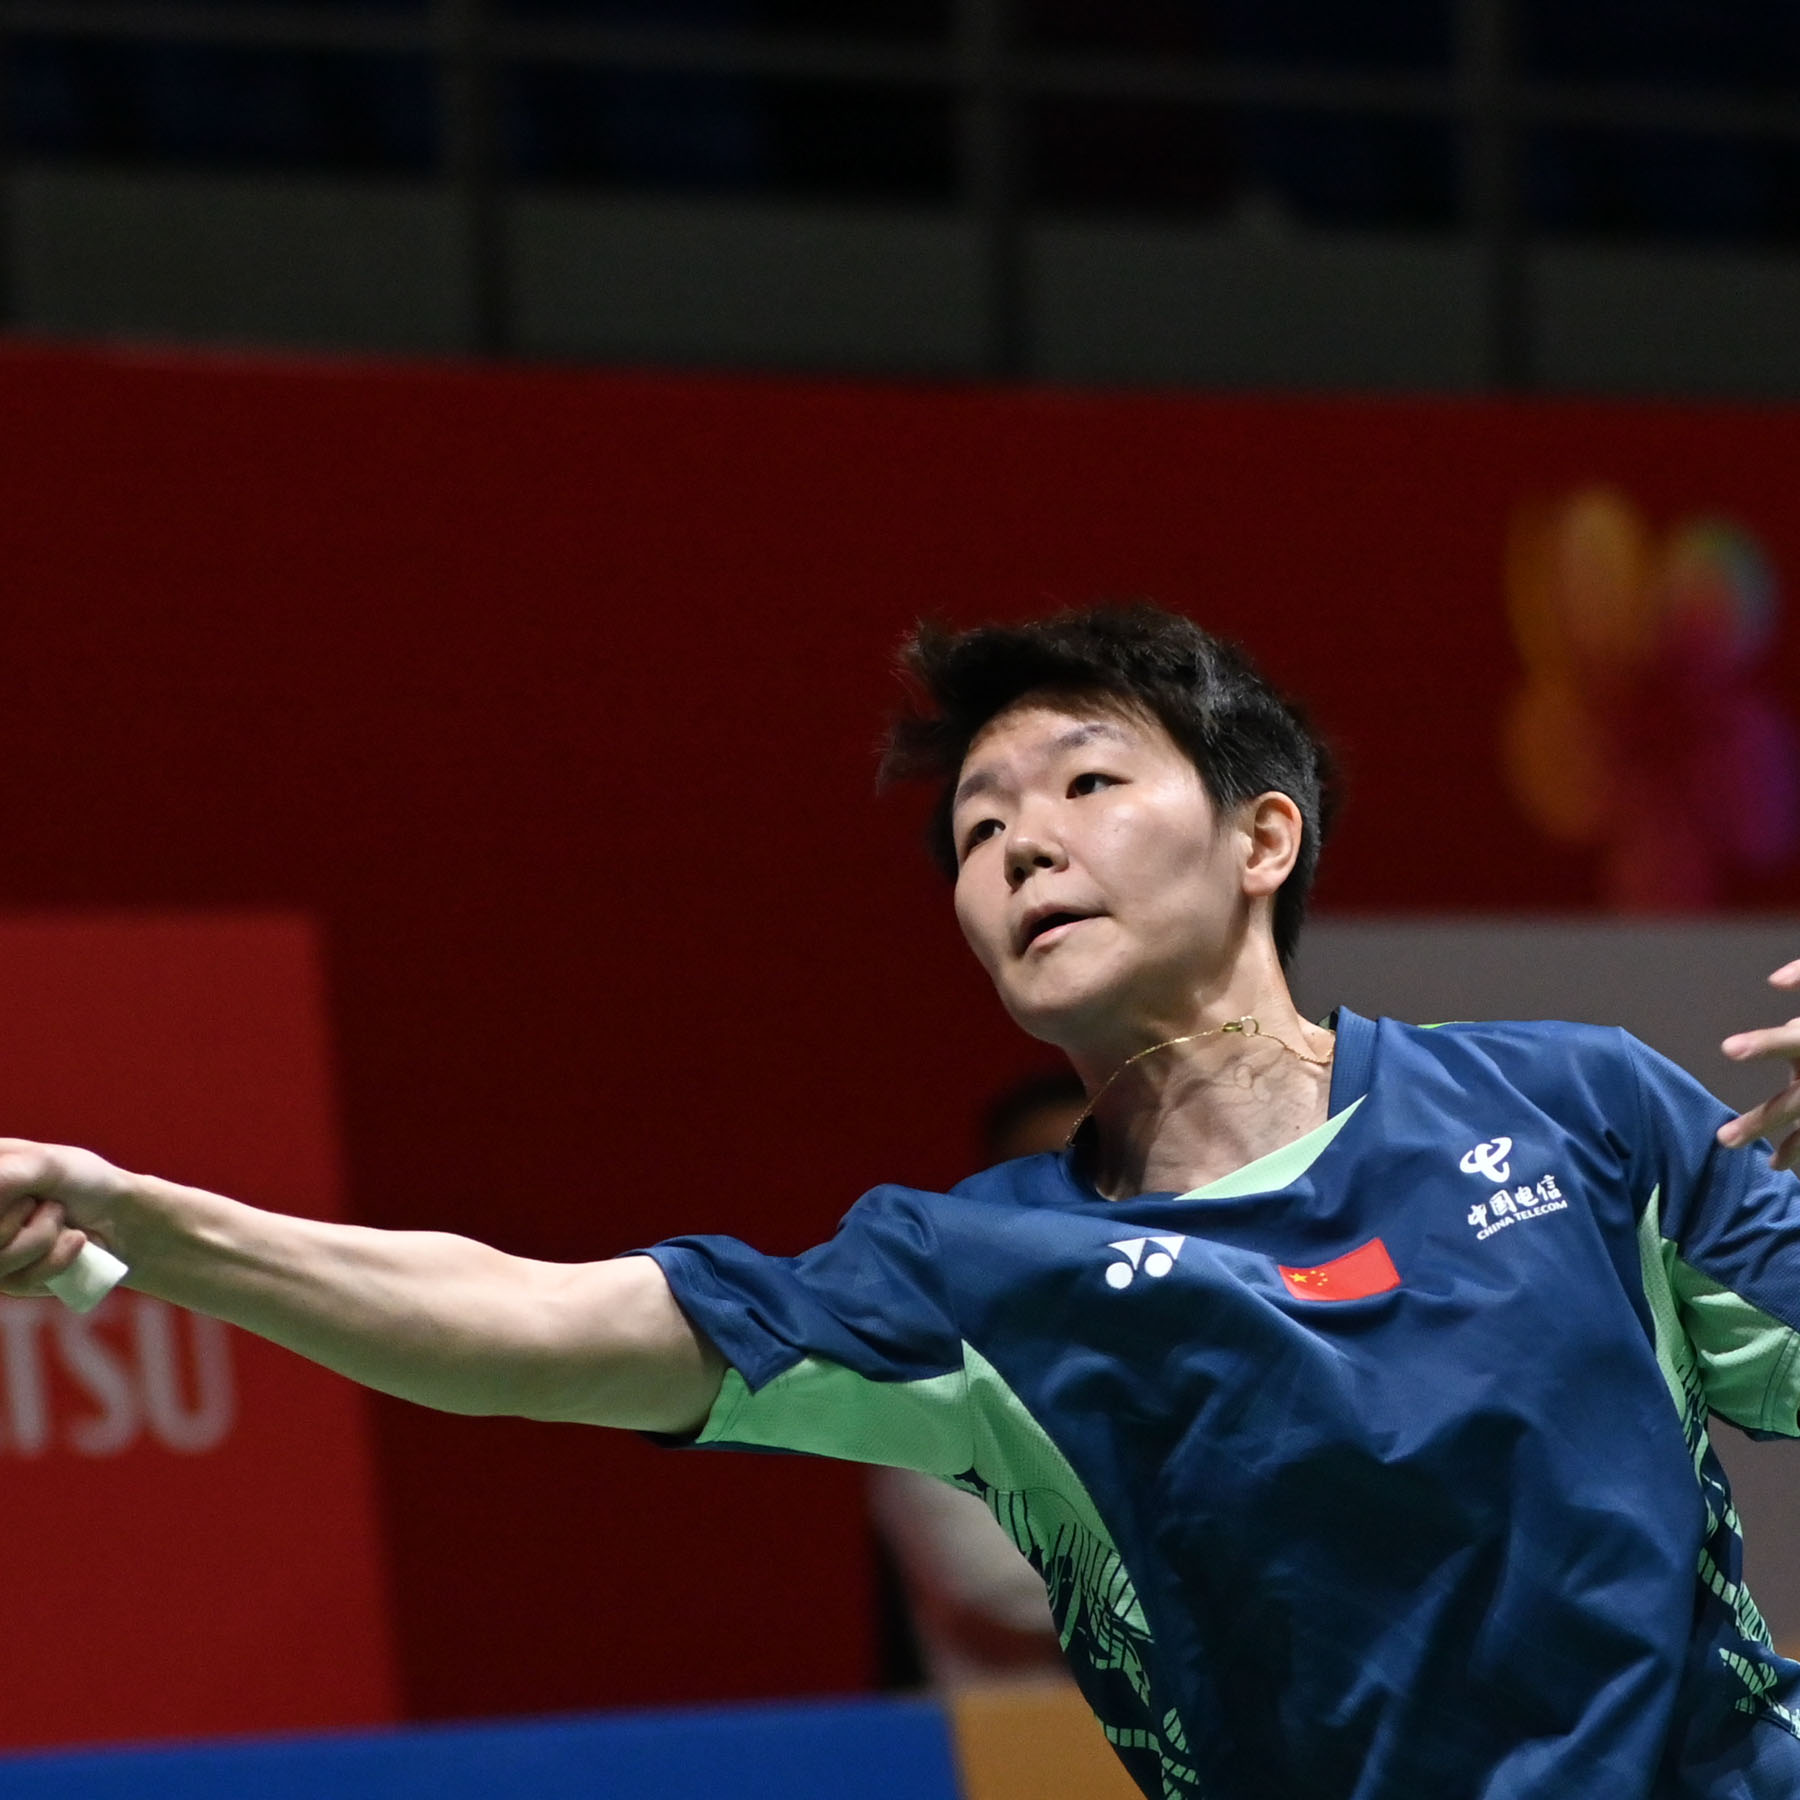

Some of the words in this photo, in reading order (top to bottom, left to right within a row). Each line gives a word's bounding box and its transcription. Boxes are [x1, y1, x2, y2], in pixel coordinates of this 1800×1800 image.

[1467, 1174, 1562, 1228] 中国电信
[1476, 1216, 1515, 1240] CHINA
[1513, 1200, 1568, 1221] TELECOM
